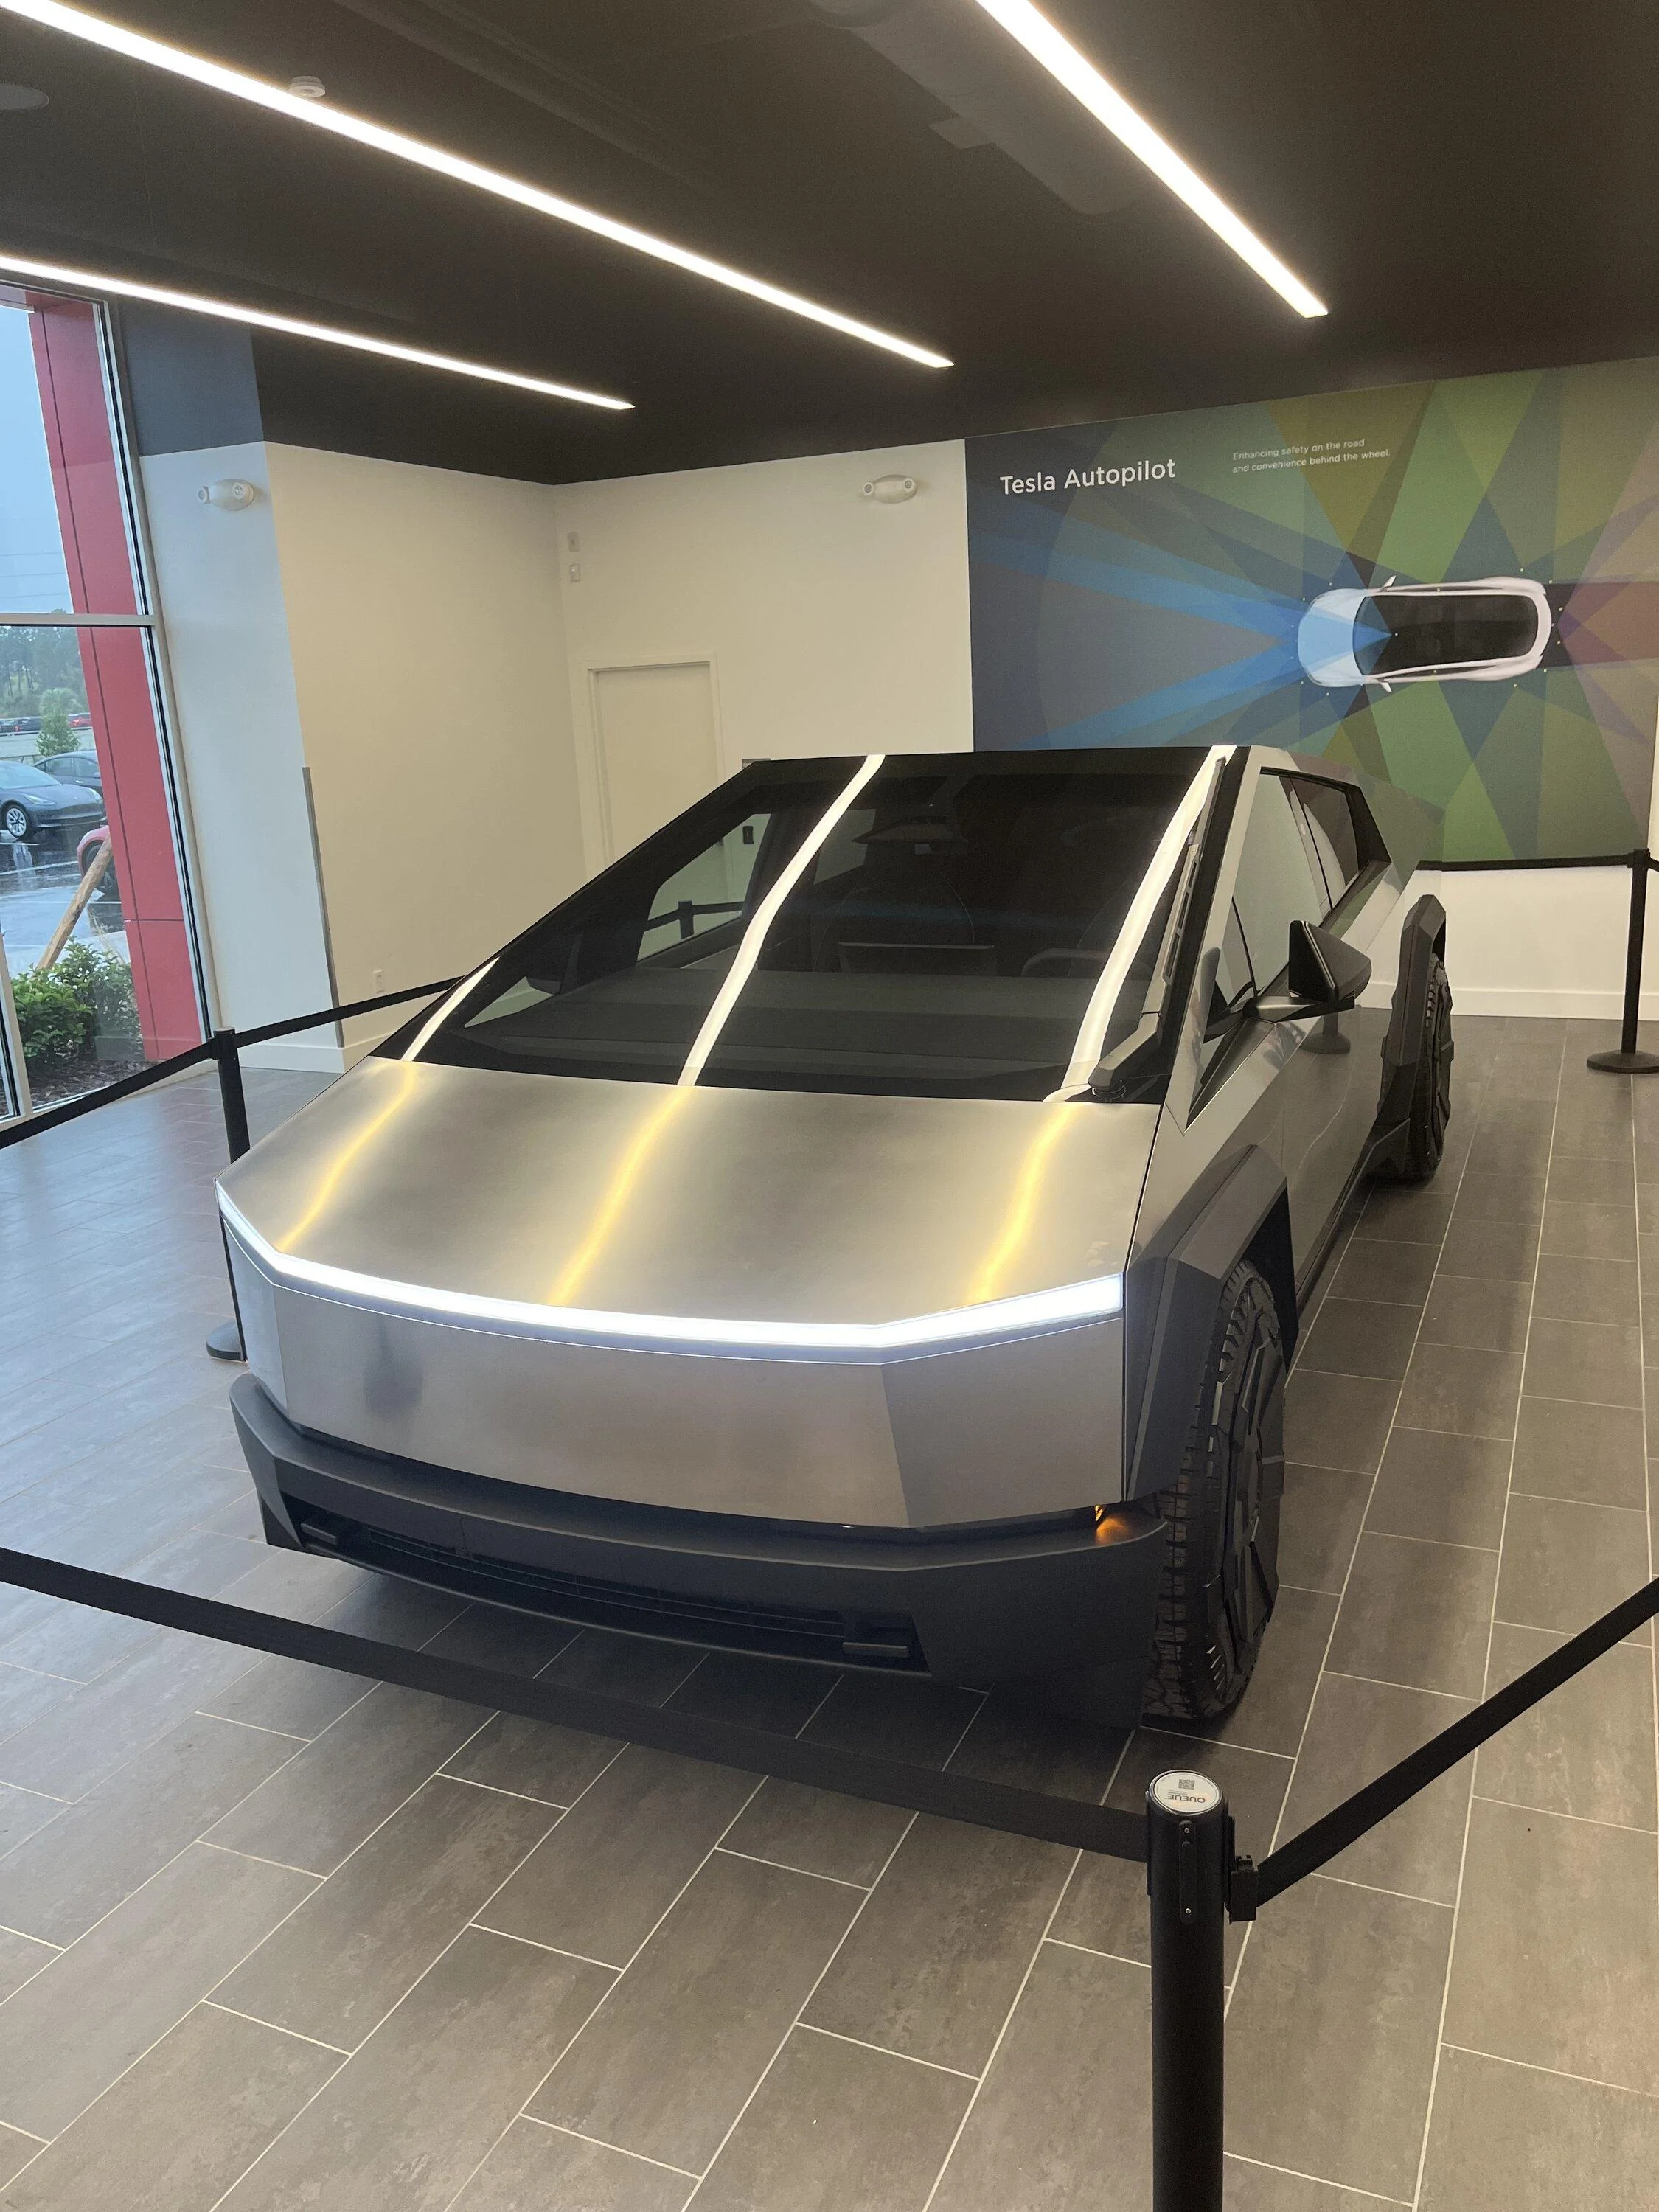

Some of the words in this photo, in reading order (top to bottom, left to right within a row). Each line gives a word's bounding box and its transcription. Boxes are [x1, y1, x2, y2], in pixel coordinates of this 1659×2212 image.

[1233, 449, 1279, 460] Enhancing
[1281, 445, 1309, 455] safety
[1312, 444, 1324, 452] on
[1326, 442, 1340, 451] the
[1343, 438, 1365, 448] road
[1233, 464, 1249, 473] and
[1252, 459, 1307, 471] convenience
[1310, 453, 1340, 465] behind
[1343, 453, 1358, 462] the
[1361, 448, 1391, 459] wheel.
[999, 471, 1056, 495] Tesla
[1064, 459, 1176, 489] Autopilot
[1168, 1794, 1206, 1803] QUEUE
